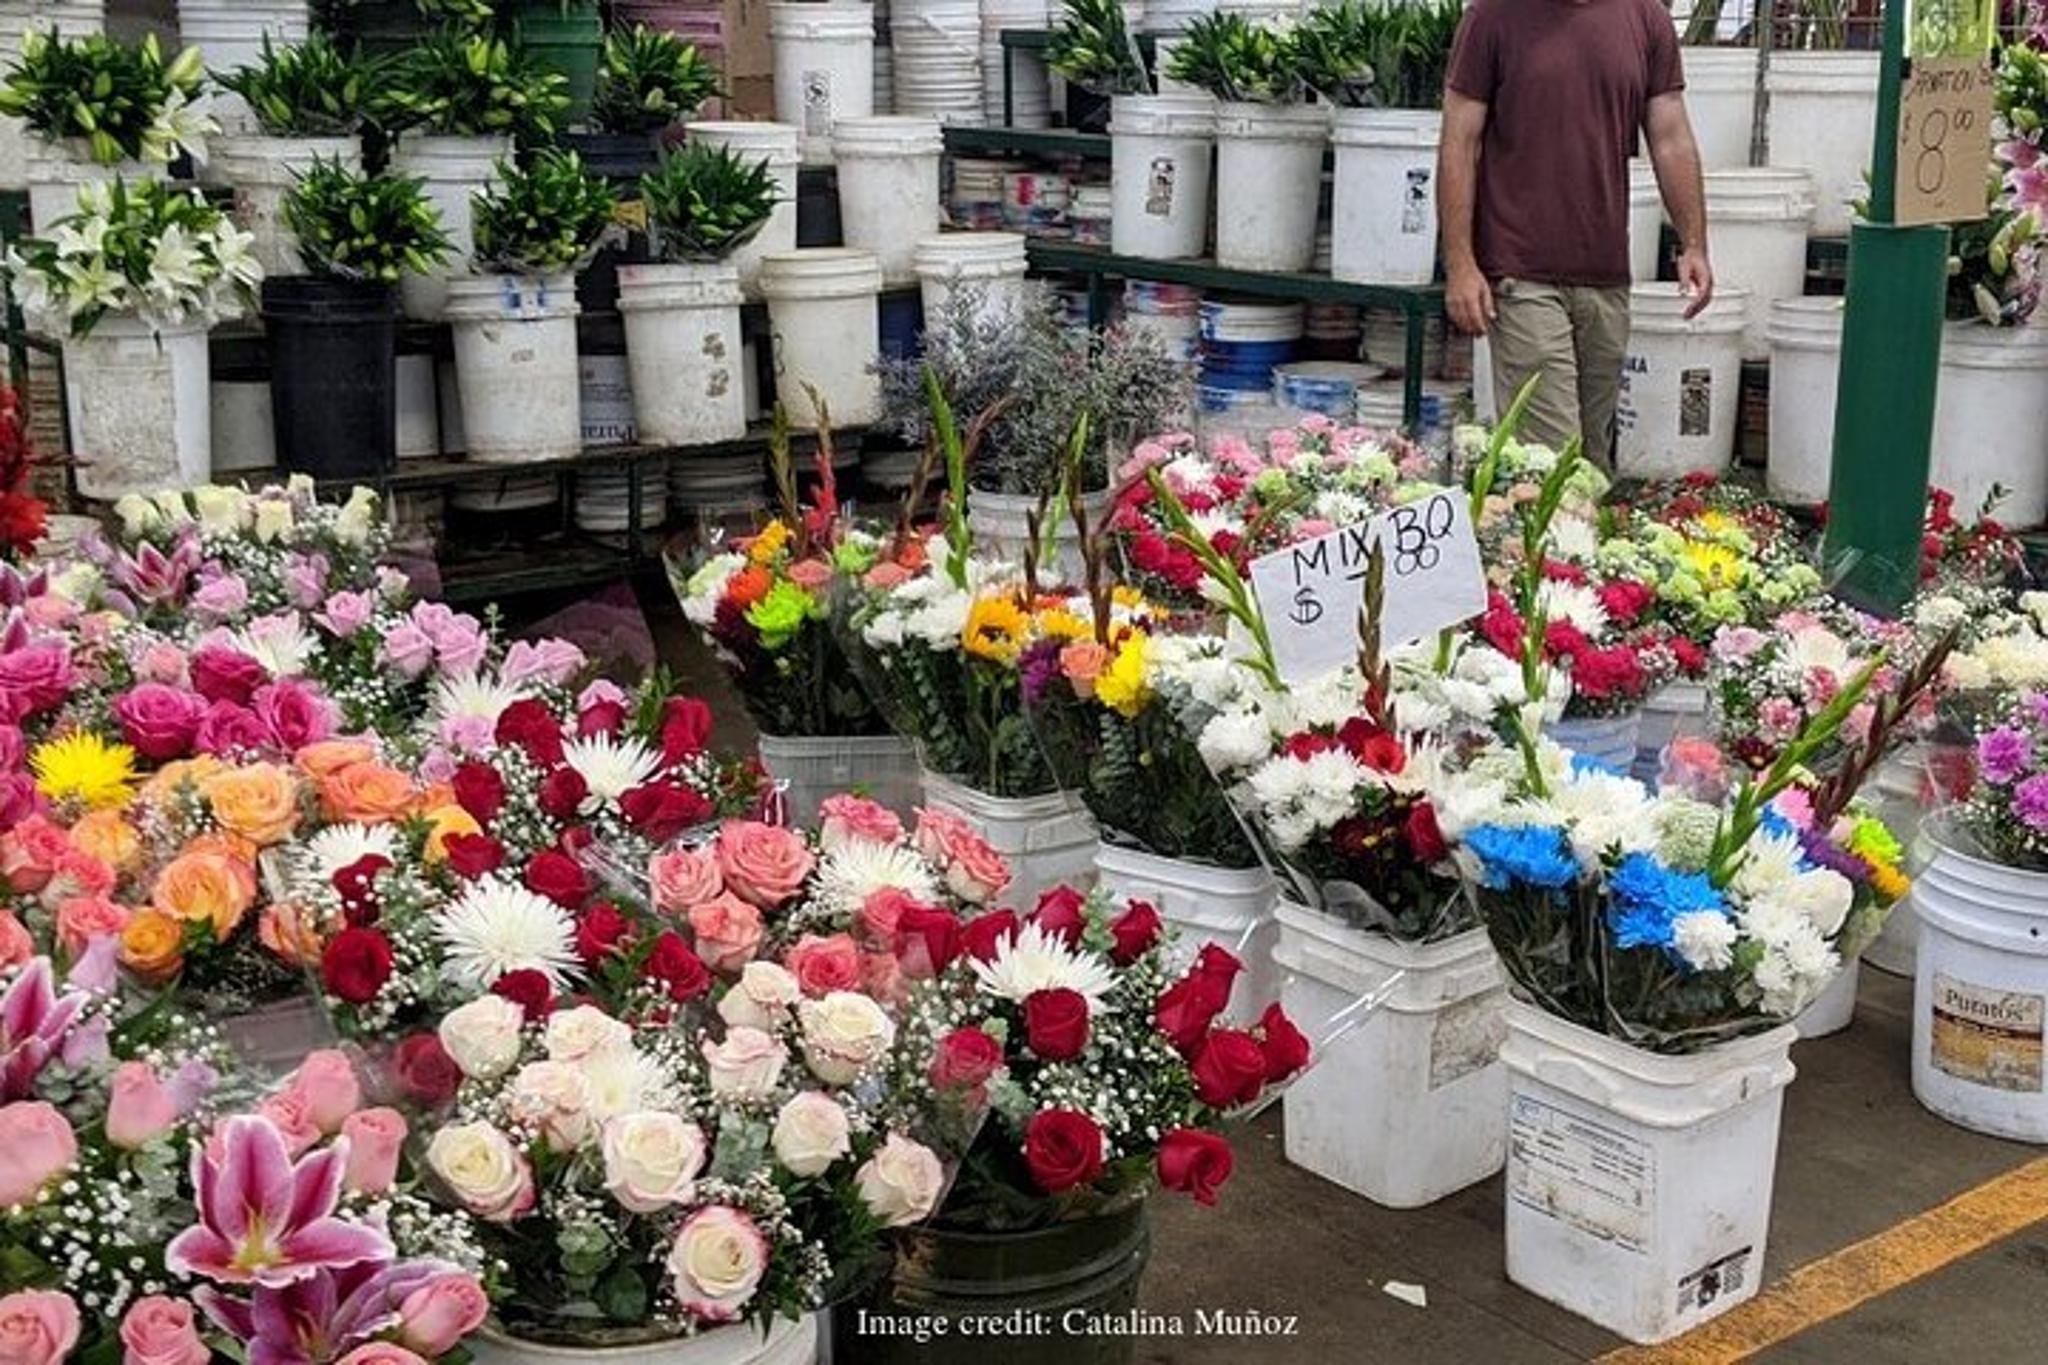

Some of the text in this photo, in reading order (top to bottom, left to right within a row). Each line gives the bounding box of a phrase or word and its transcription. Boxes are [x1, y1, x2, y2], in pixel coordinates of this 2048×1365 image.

[1292, 520, 1373, 586] MIX
[1288, 587, 1324, 626] $
[1945, 988, 2023, 1022] Puratos
